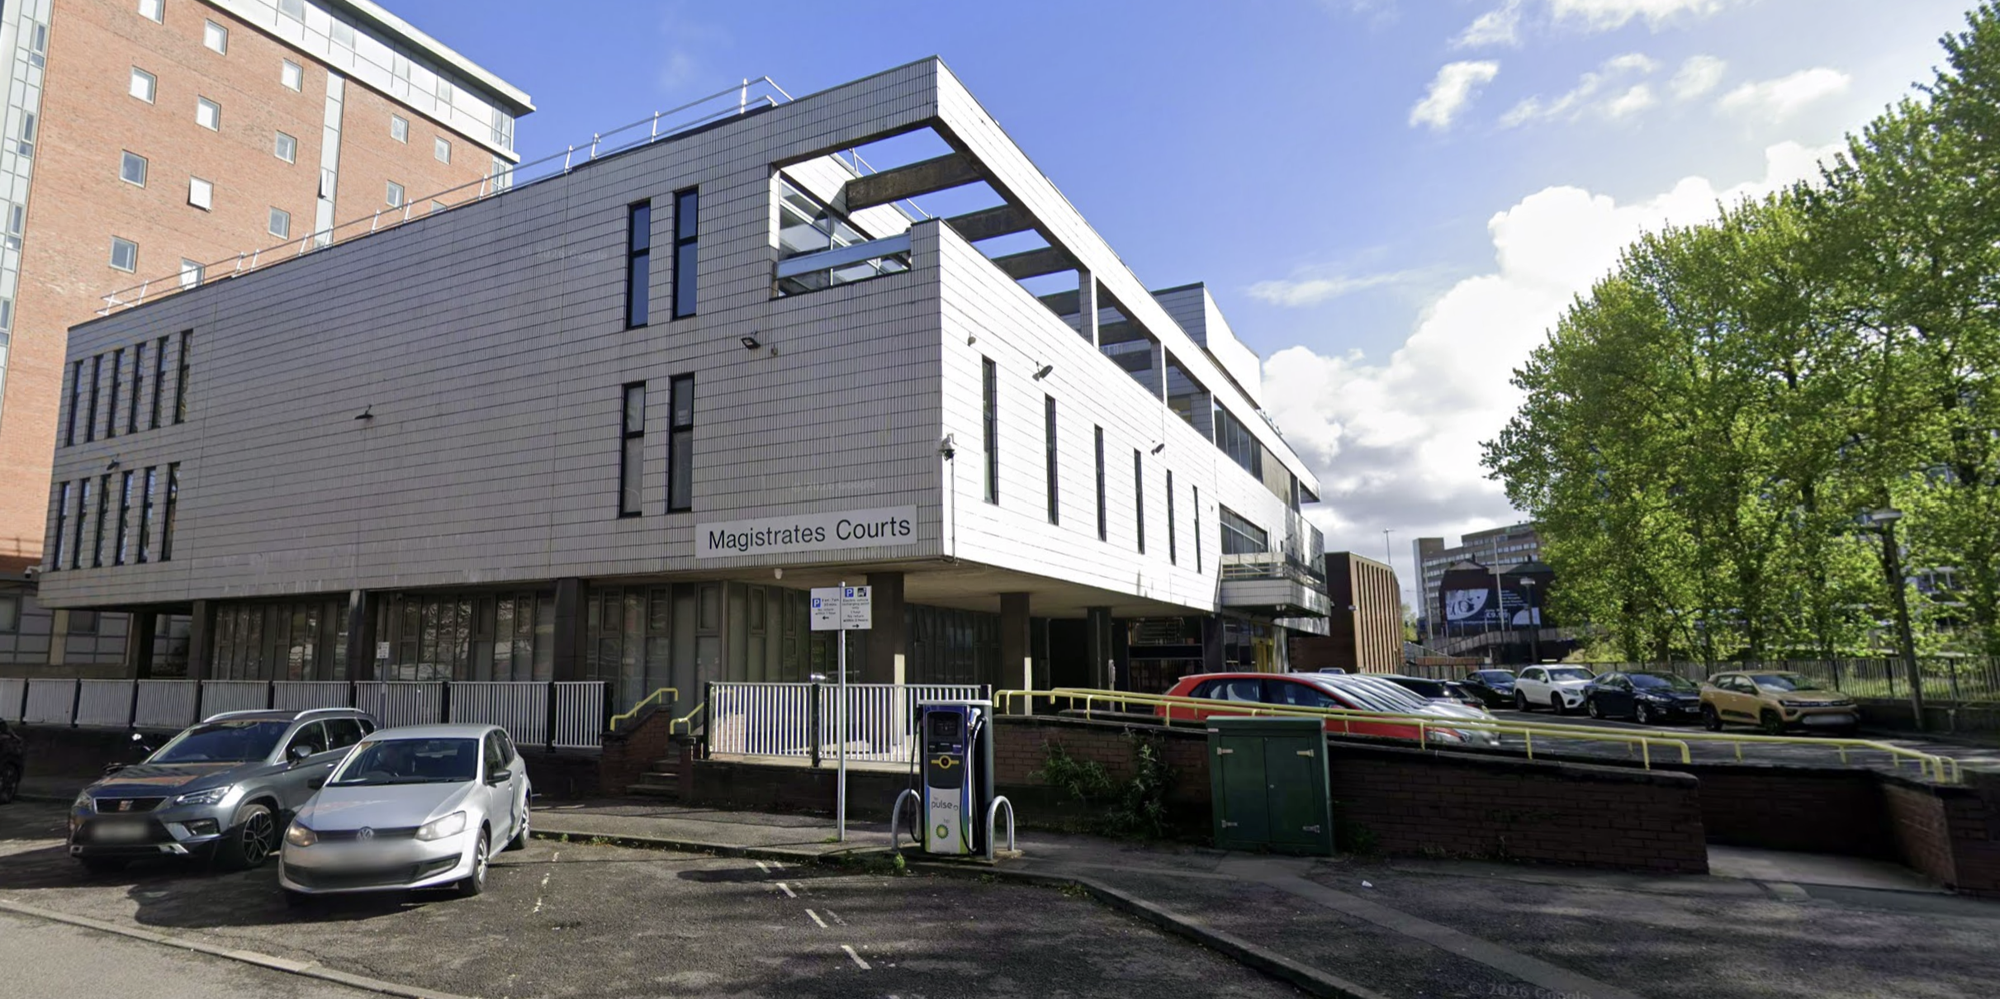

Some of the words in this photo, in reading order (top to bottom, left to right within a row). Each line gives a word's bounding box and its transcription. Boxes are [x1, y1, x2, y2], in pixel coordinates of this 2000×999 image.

[709, 525, 826, 551] Magistrates
[836, 517, 911, 540] Courts
[931, 800, 953, 810] pulse
